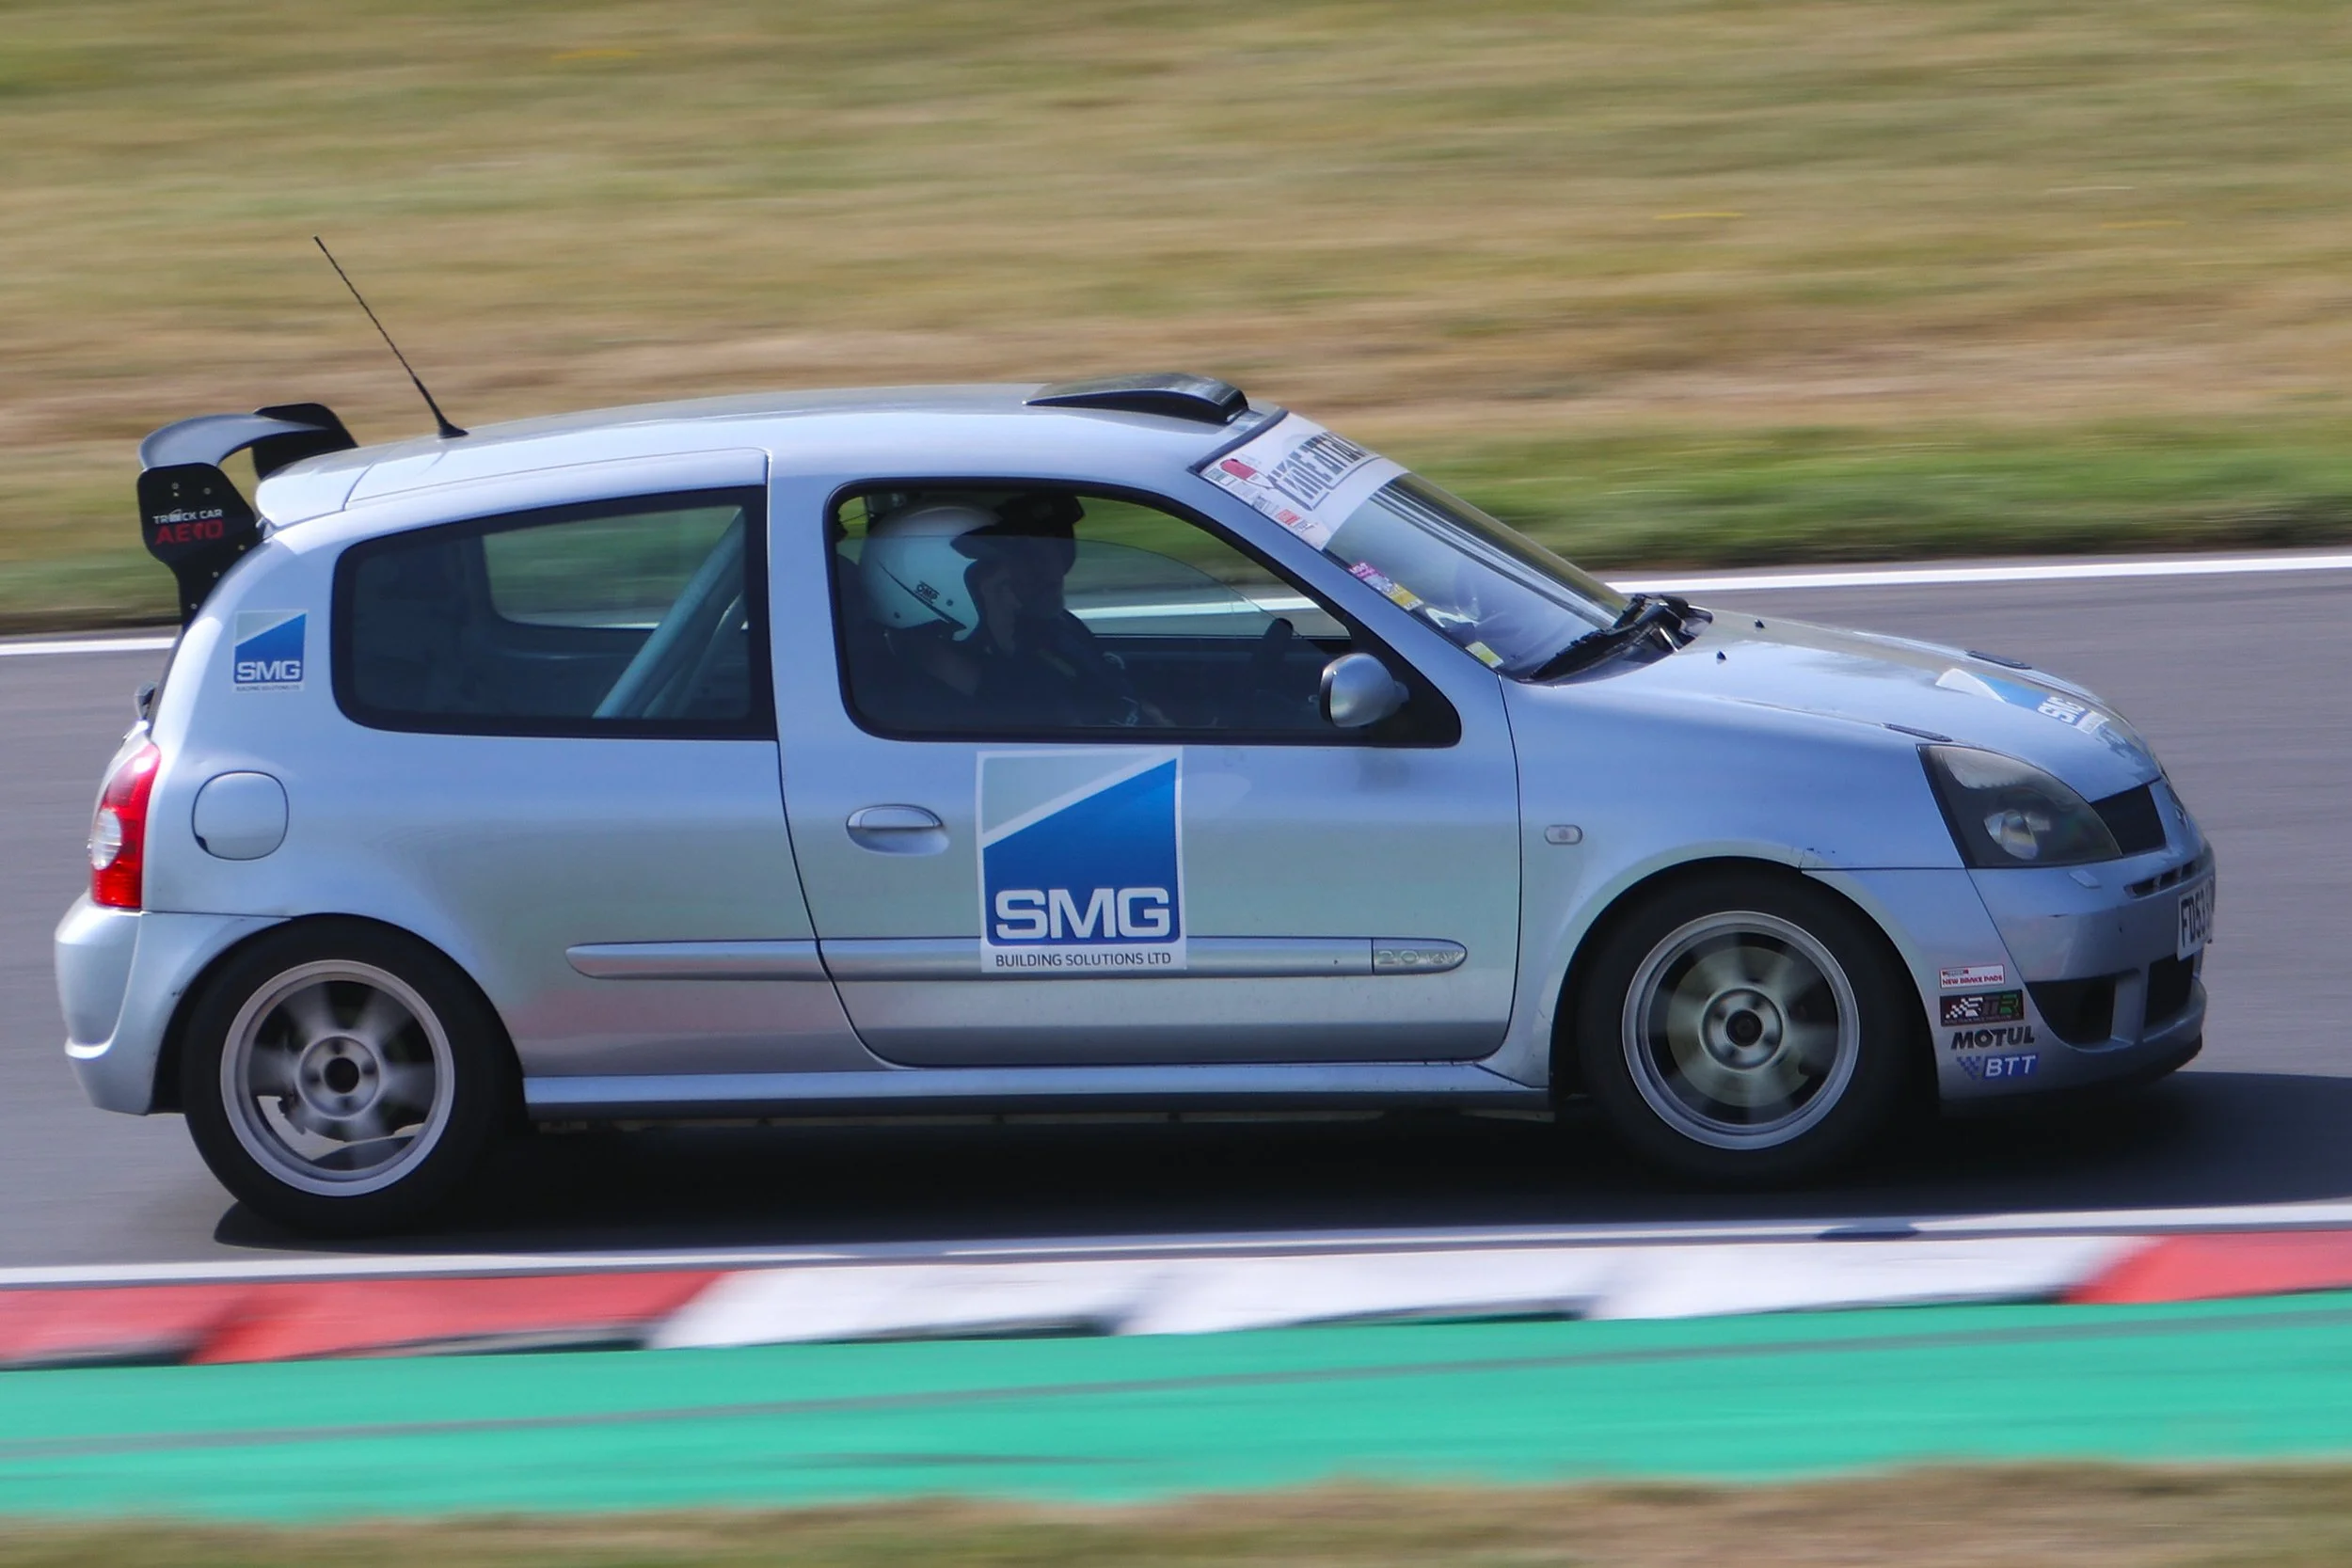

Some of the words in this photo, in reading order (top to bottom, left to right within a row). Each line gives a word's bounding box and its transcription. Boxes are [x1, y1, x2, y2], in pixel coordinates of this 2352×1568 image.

[199, 509, 223, 519] CAR
[236, 660, 301, 681] SMG
[995, 887, 1171, 940] SMG
[995, 953, 1062, 968] BUILDING
[1066, 952, 1144, 967] SOLUTIONS
[1147, 952, 1172, 965] LTD
[1942, 976, 1959, 986] NEW
[1959, 975, 1983, 985] BRAKE
[1983, 974, 2004, 983] PADS
[1950, 1025, 2036, 1051] MOTUL
[1984, 1054, 2037, 1078] BTT
